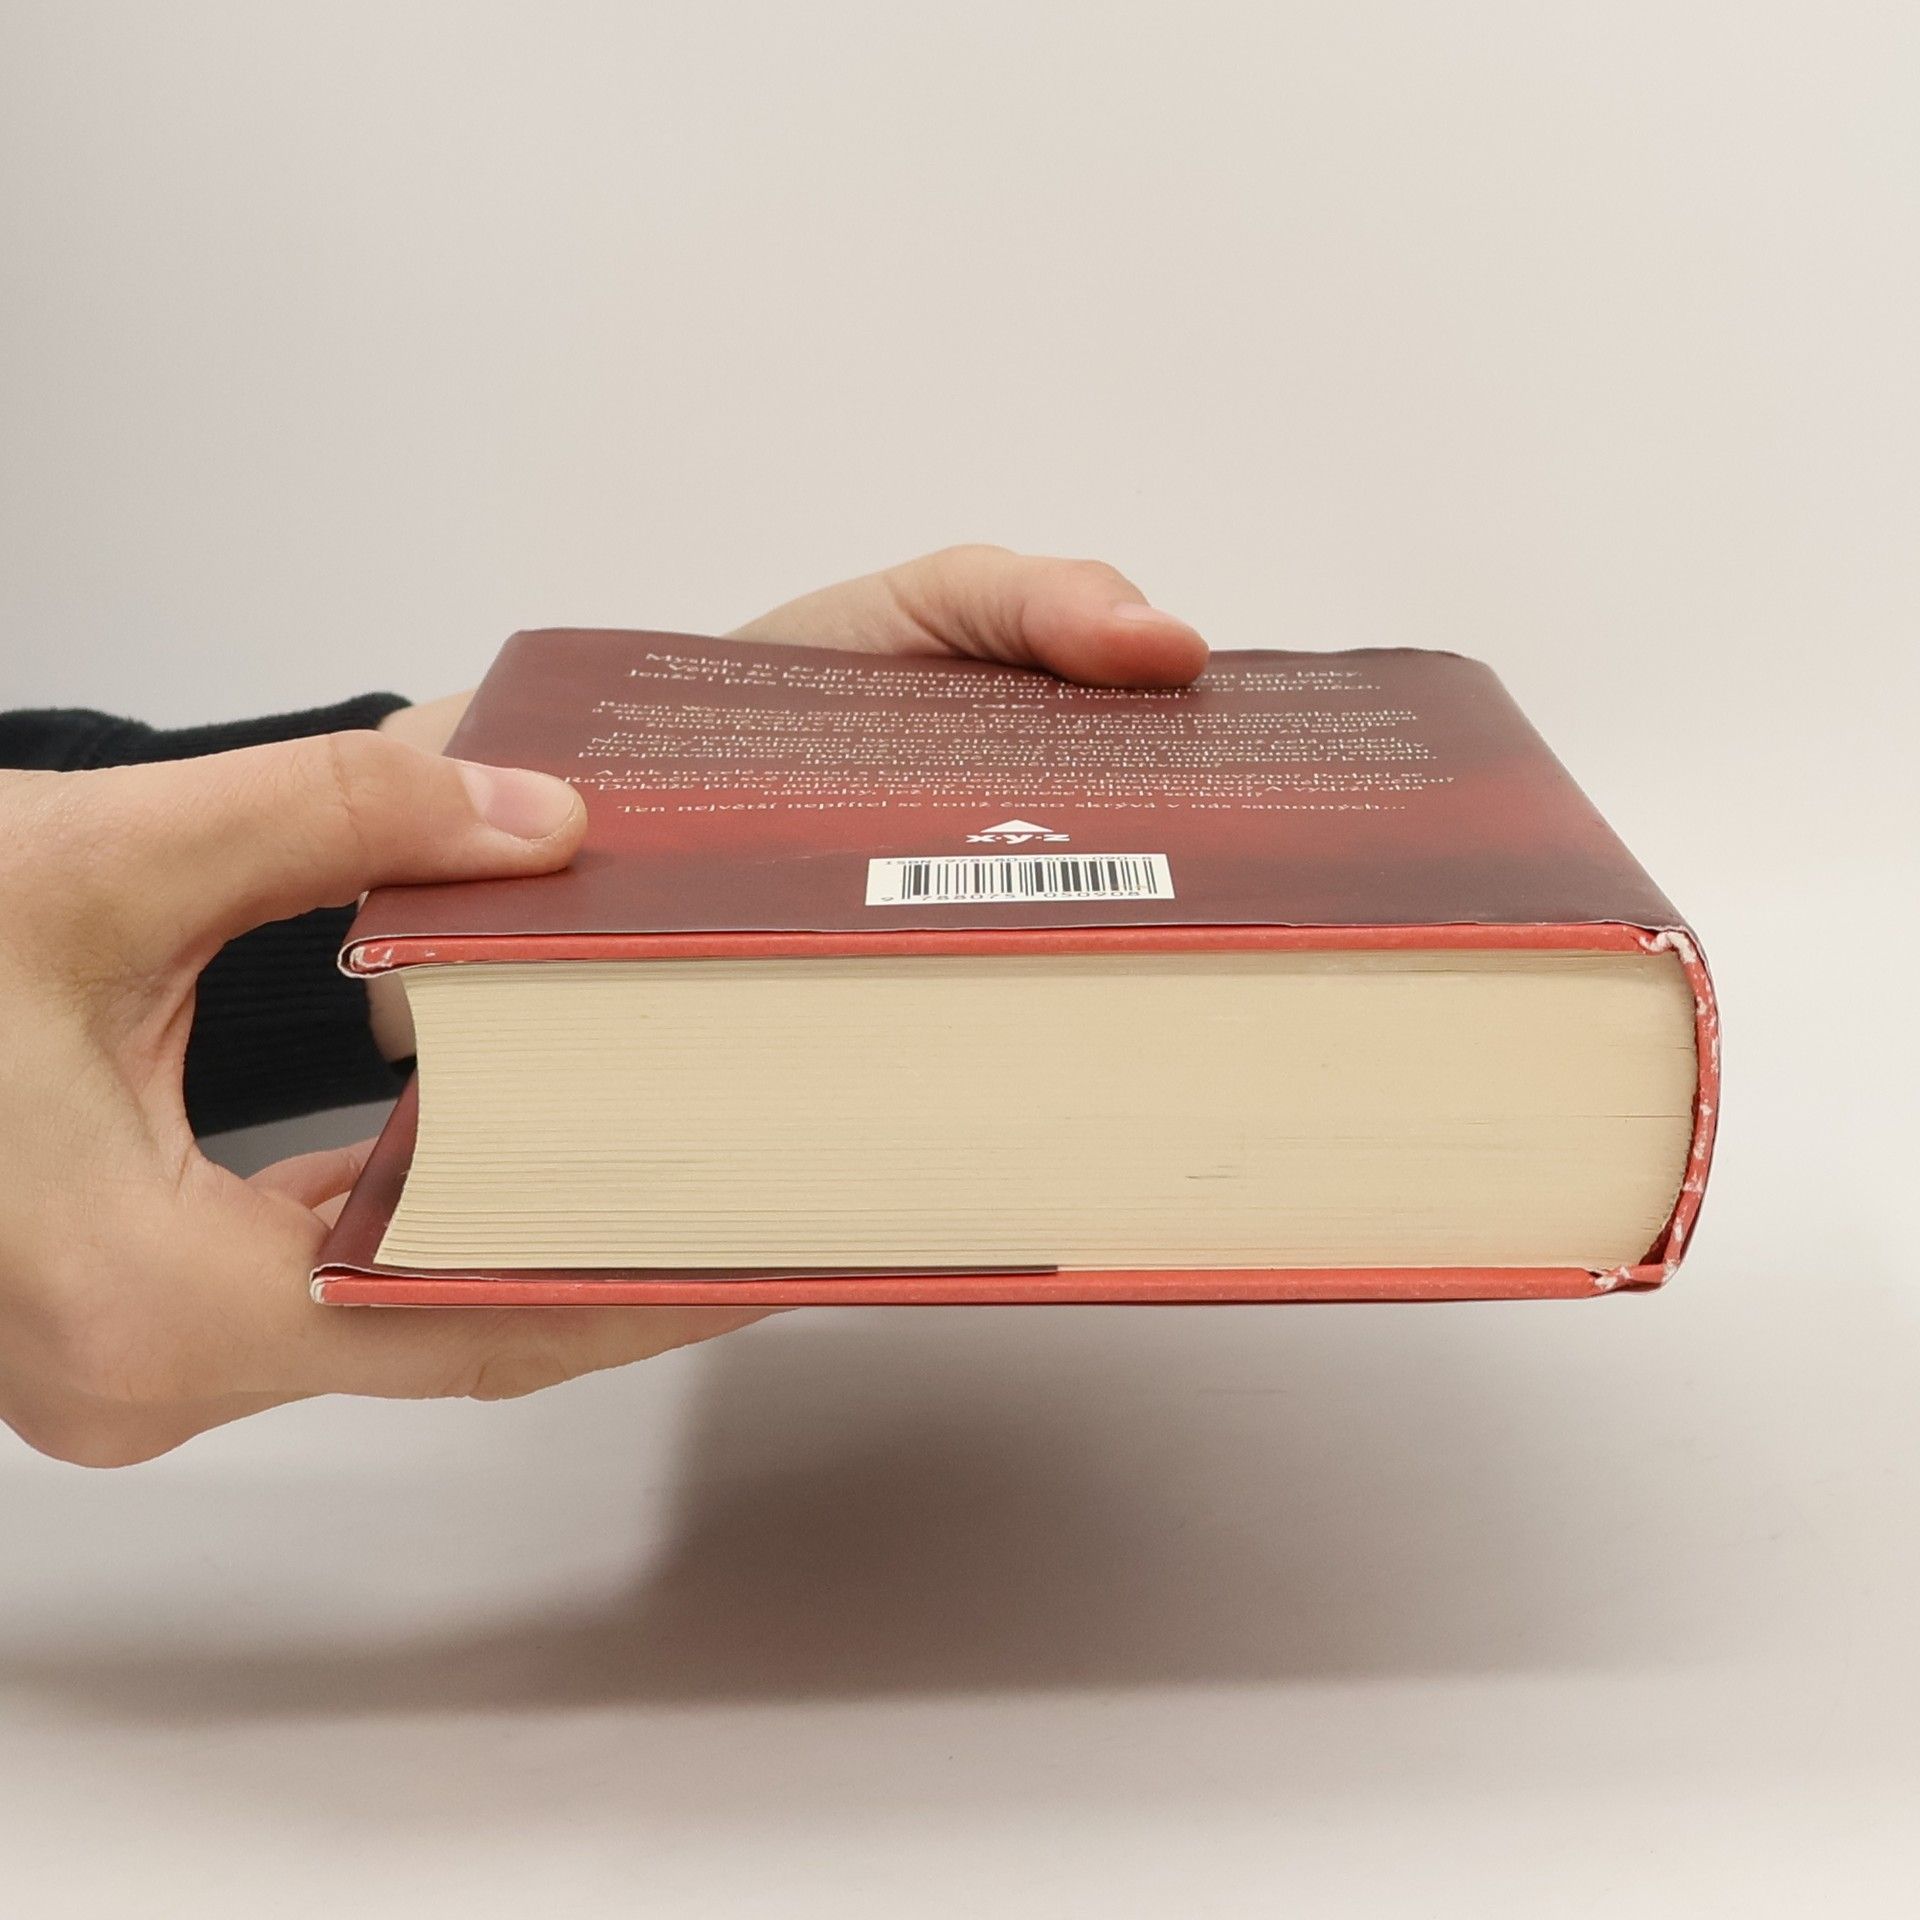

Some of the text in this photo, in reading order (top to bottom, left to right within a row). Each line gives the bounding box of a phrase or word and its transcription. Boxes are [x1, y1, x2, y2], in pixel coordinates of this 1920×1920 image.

[646, 653, 743, 667] Myslela
[824, 667, 864, 676] její
[669, 663, 736, 676] Věřil,
[782, 671, 845, 682] kvůli
[858, 677, 938, 686] svému
[1246, 671, 1286, 679] bez
[1296, 670, 1362, 679] lásky.
[625, 668, 697, 681] Jenže
[724, 677, 777, 686] přes
[787, 681, 917, 692] naprostou
[1245, 684, 1303, 692] stalo
[1241, 678, 1342, 686] milovat.
[915, 690, 986, 700] jeden
[1018, 692, 1074, 700] nich
[1085, 692, 1189, 700] nečekal.
[600, 700, 671, 711] Raven
[911, 711, 979, 719] mladá
[1341, 709, 1413, 717] studiu
[892, 716, 965, 724] umění
[735, 724, 824, 733] Dokáže
[577, 751, 622, 759] pro
[801, 758, 843, 766] aby
[624, 768, 663, 777] jak
[706, 768, 755, 776] celé
[565, 776, 642, 784] Raven
[598, 782, 695, 790] Dokáže
[617, 804, 666, 813] Ten
[676, 803, 777, 812] největší
[787, 801, 887, 811] nepřítel
[933, 800, 992, 808] totiž
[1074, 801, 1156, 810] skrývá
[922, 893, 1017, 901] 788075
